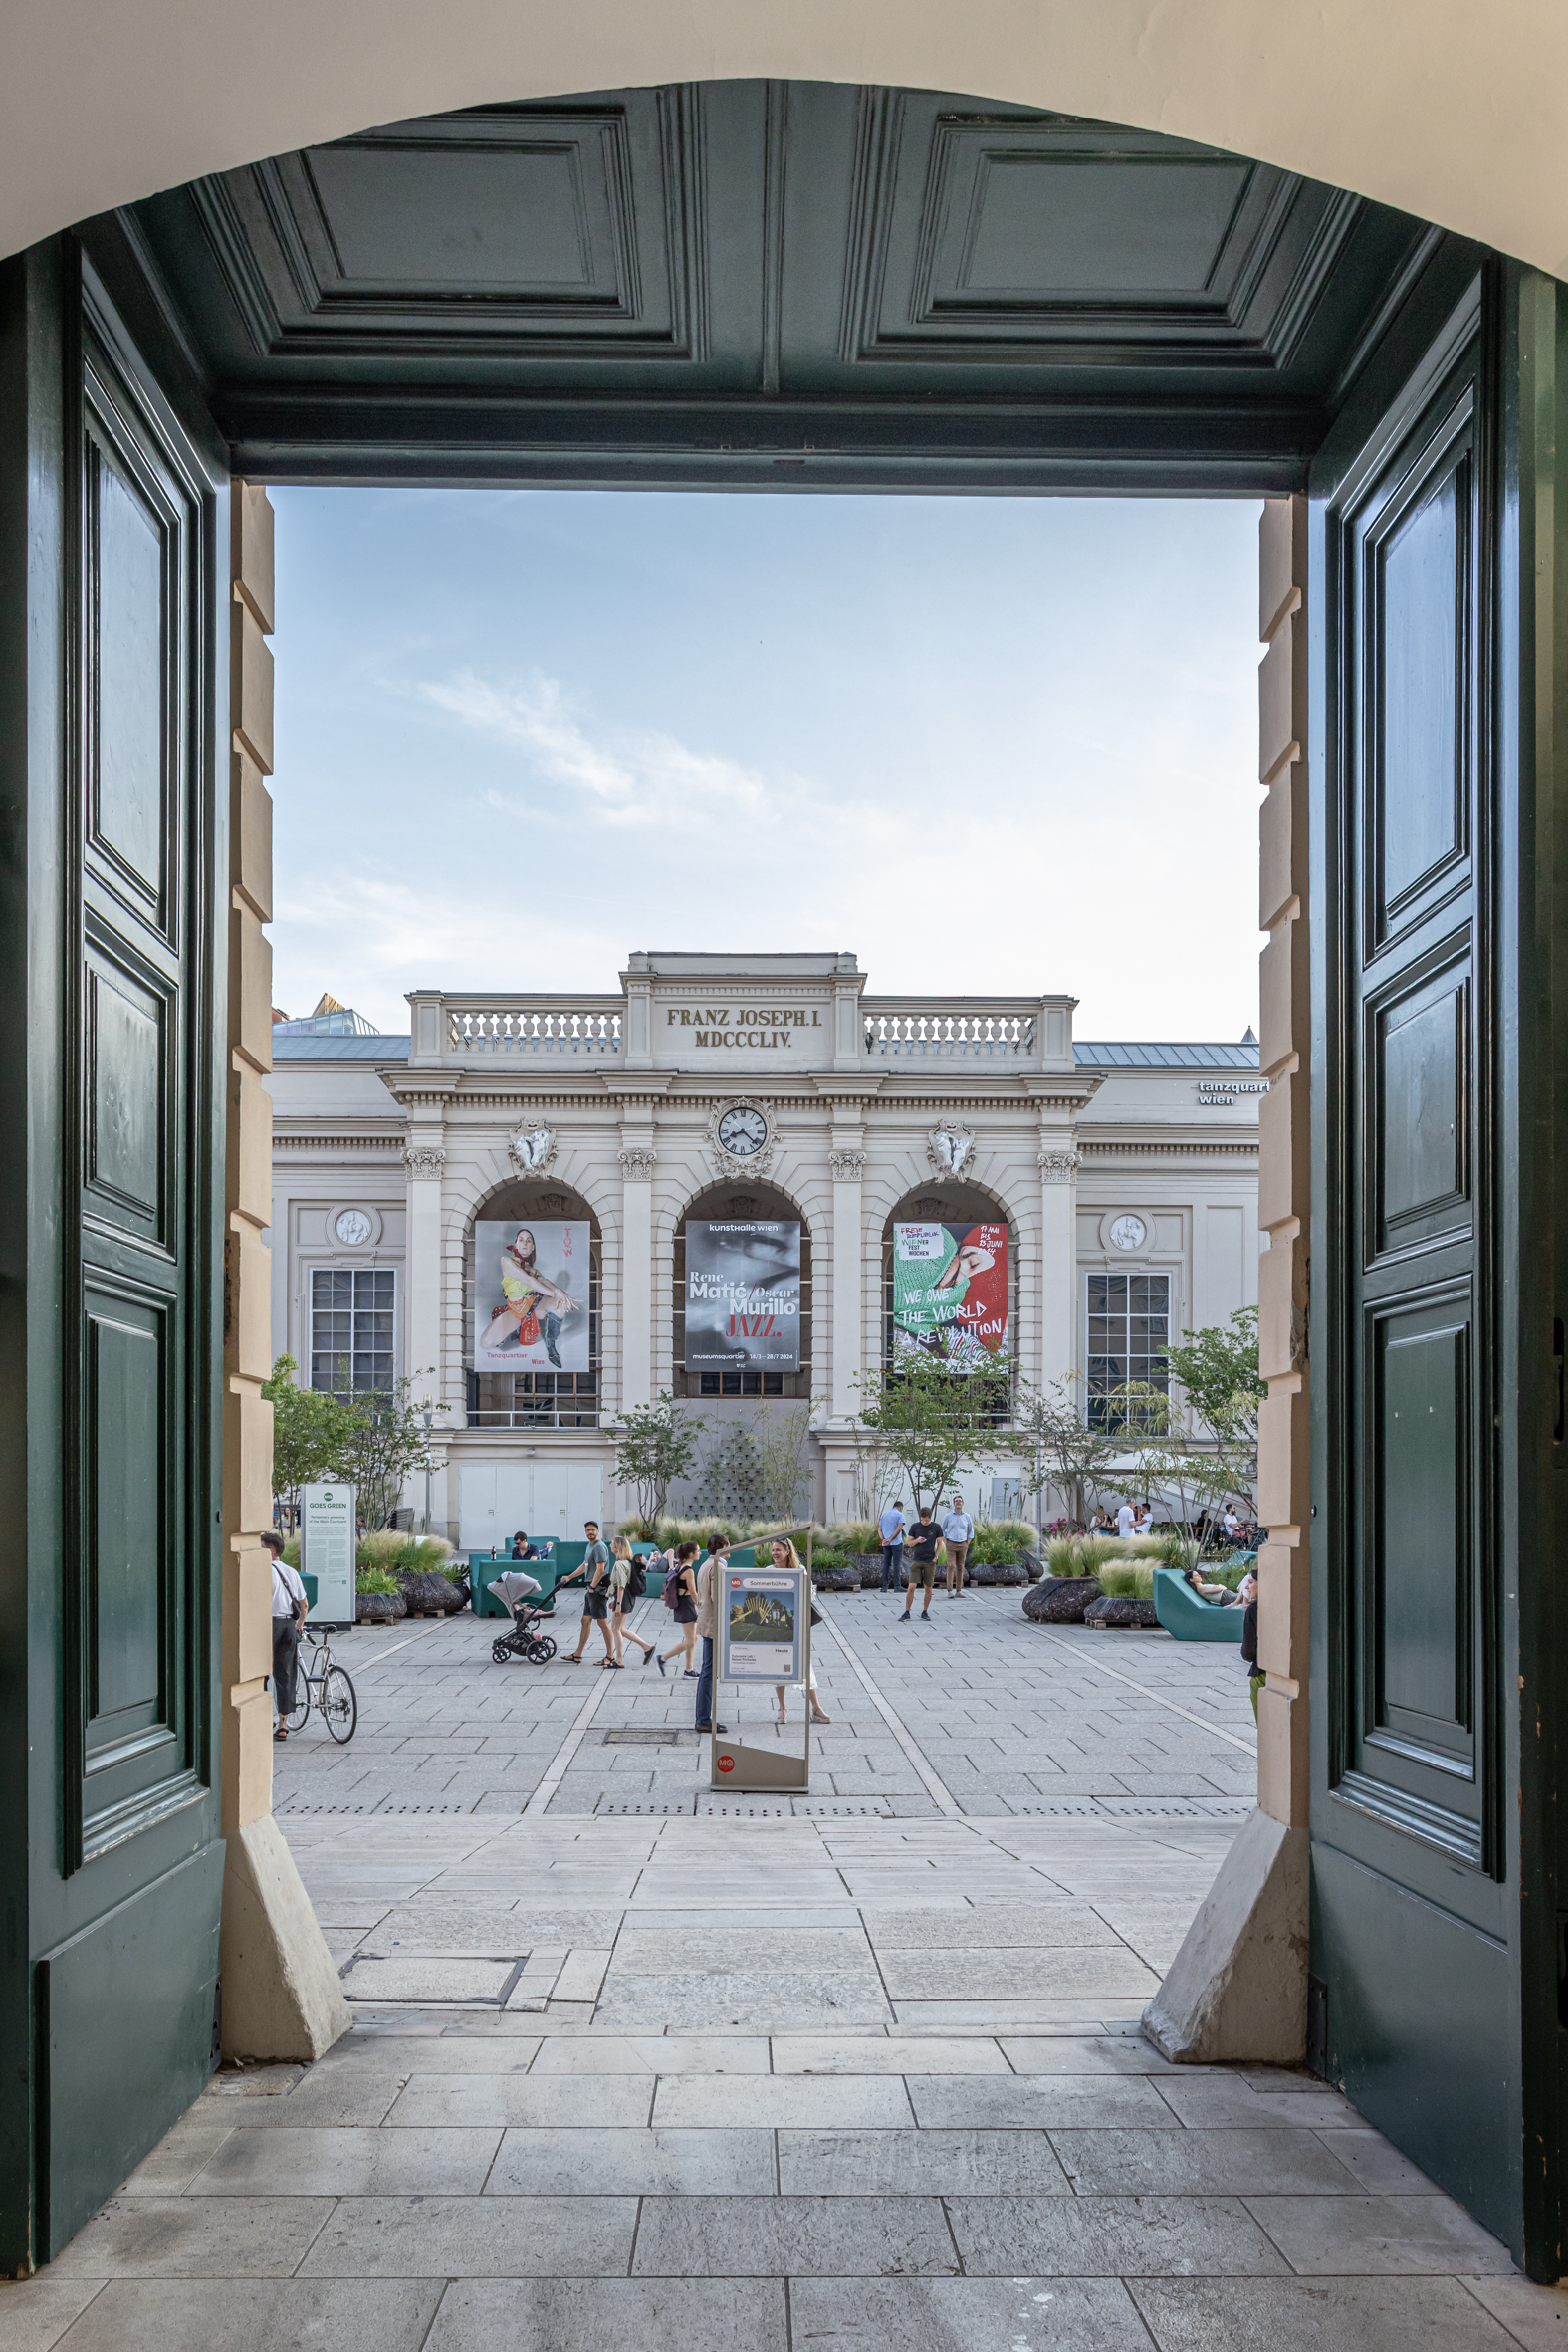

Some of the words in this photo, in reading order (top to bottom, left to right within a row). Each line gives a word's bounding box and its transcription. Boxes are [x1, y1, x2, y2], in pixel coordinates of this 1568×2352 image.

[667, 1009, 730, 1026] FRANZ
[695, 1031, 792, 1048] MDCCCLIV.
[1199, 1093, 1234, 1105] wien
[690, 1271, 723, 1282] Rene
[690, 1281, 747, 1299] Matić
[755, 1287, 795, 1298] Oscar
[904, 1289, 923, 1305] WE
[926, 1287, 951, 1302] OWE
[729, 1298, 796, 1315] Murillo
[898, 1309, 928, 1326] THE
[932, 1301, 987, 1323] WORLD
[725, 1315, 782, 1337] JAZZ.
[901, 1331, 912, 1345] A
